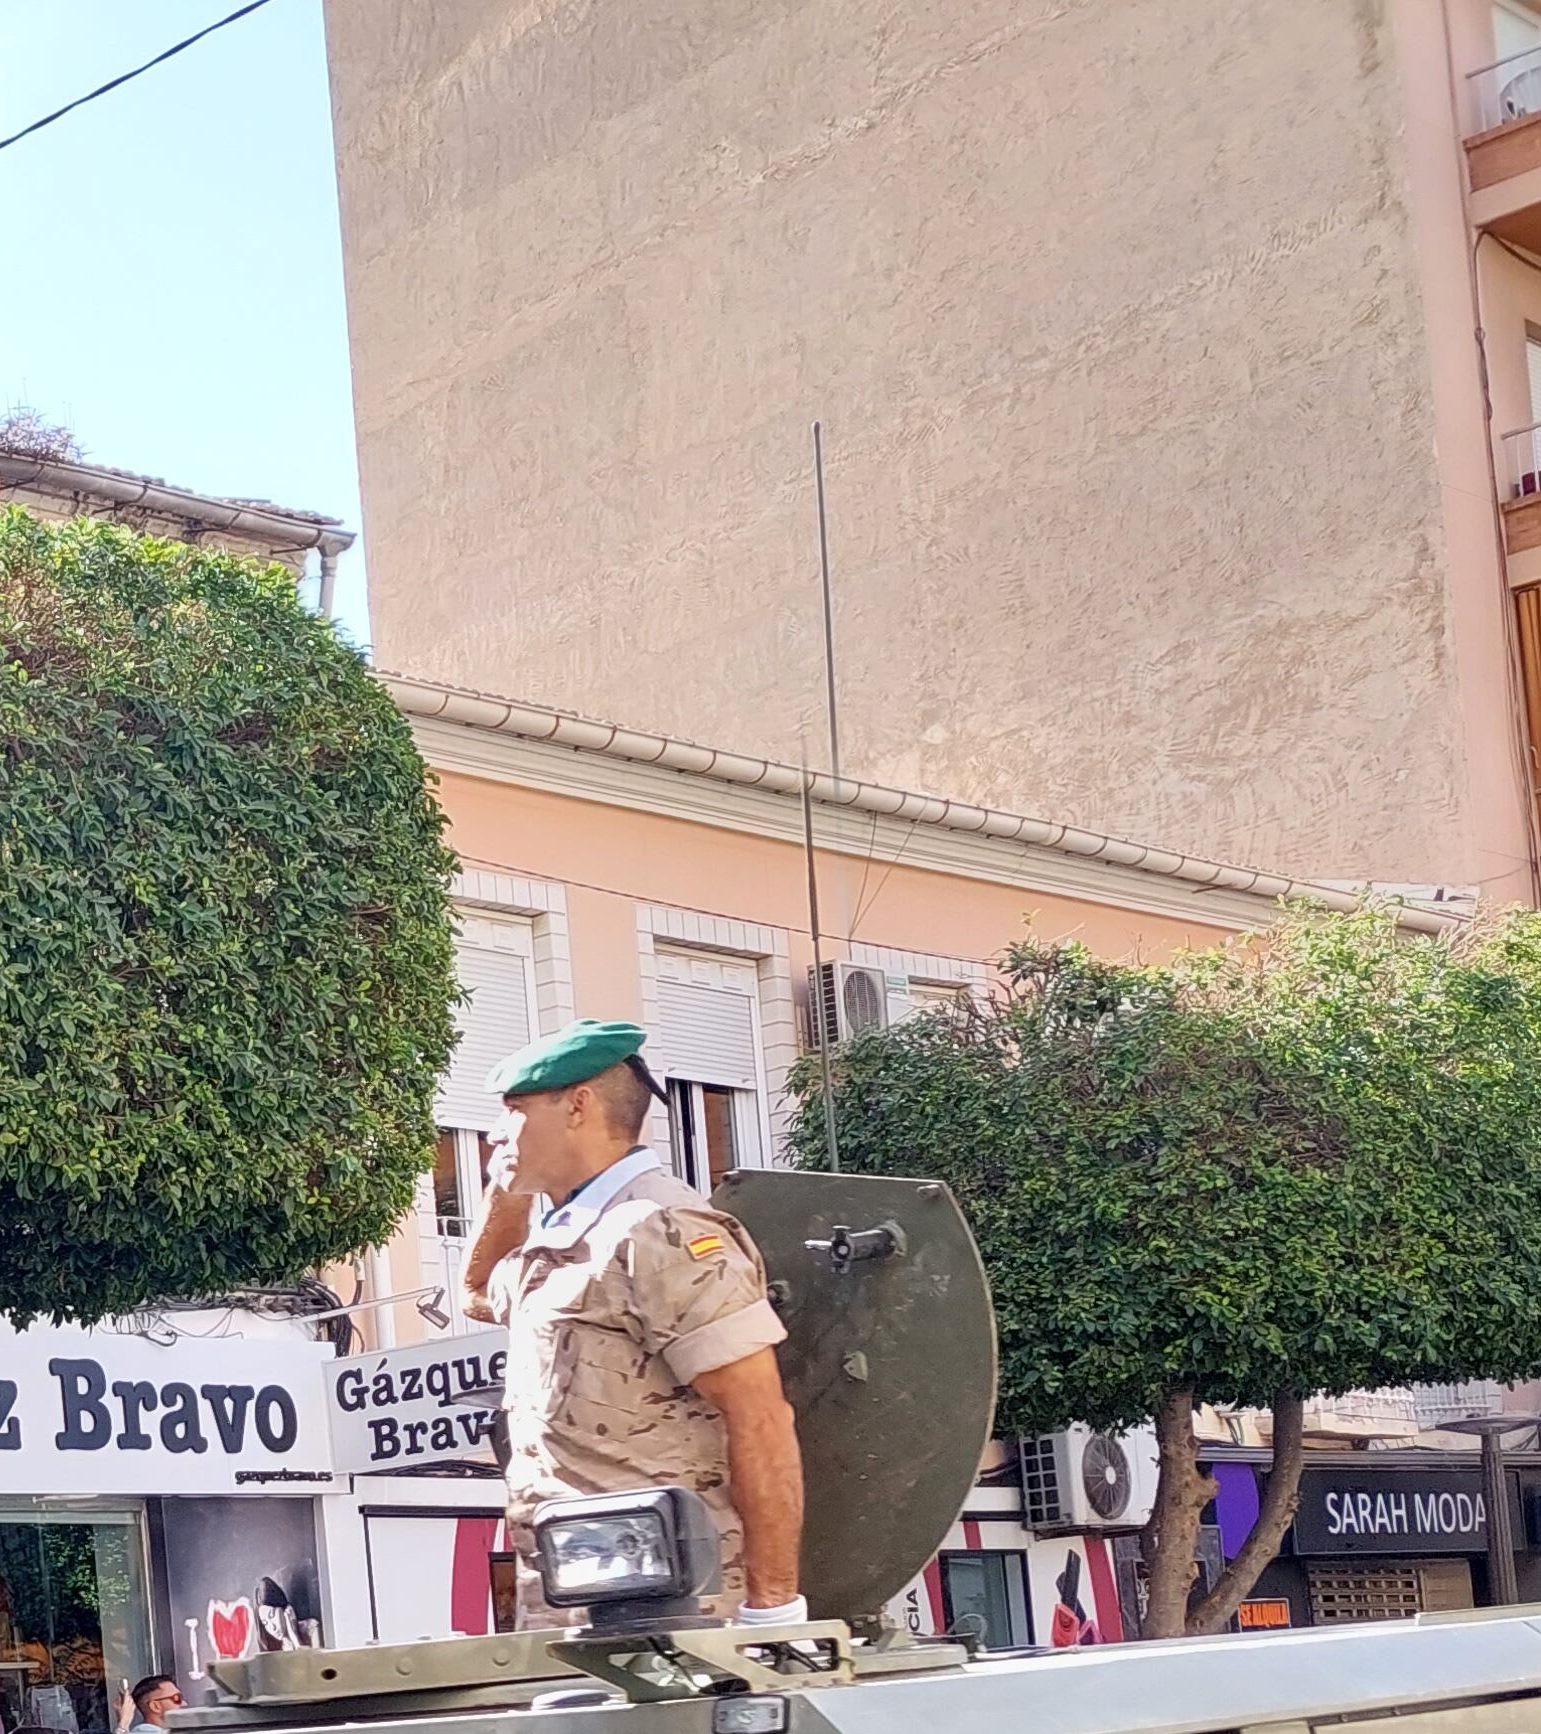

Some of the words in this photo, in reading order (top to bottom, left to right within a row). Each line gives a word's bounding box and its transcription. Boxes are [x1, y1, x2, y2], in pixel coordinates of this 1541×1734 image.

[48, 1357, 299, 1454] Bravo
[335, 1350, 509, 1413] Gázque
[367, 1409, 500, 1462] Brav
[1325, 1491, 1409, 1535] SARAH
[1414, 1492, 1487, 1534] MODA
